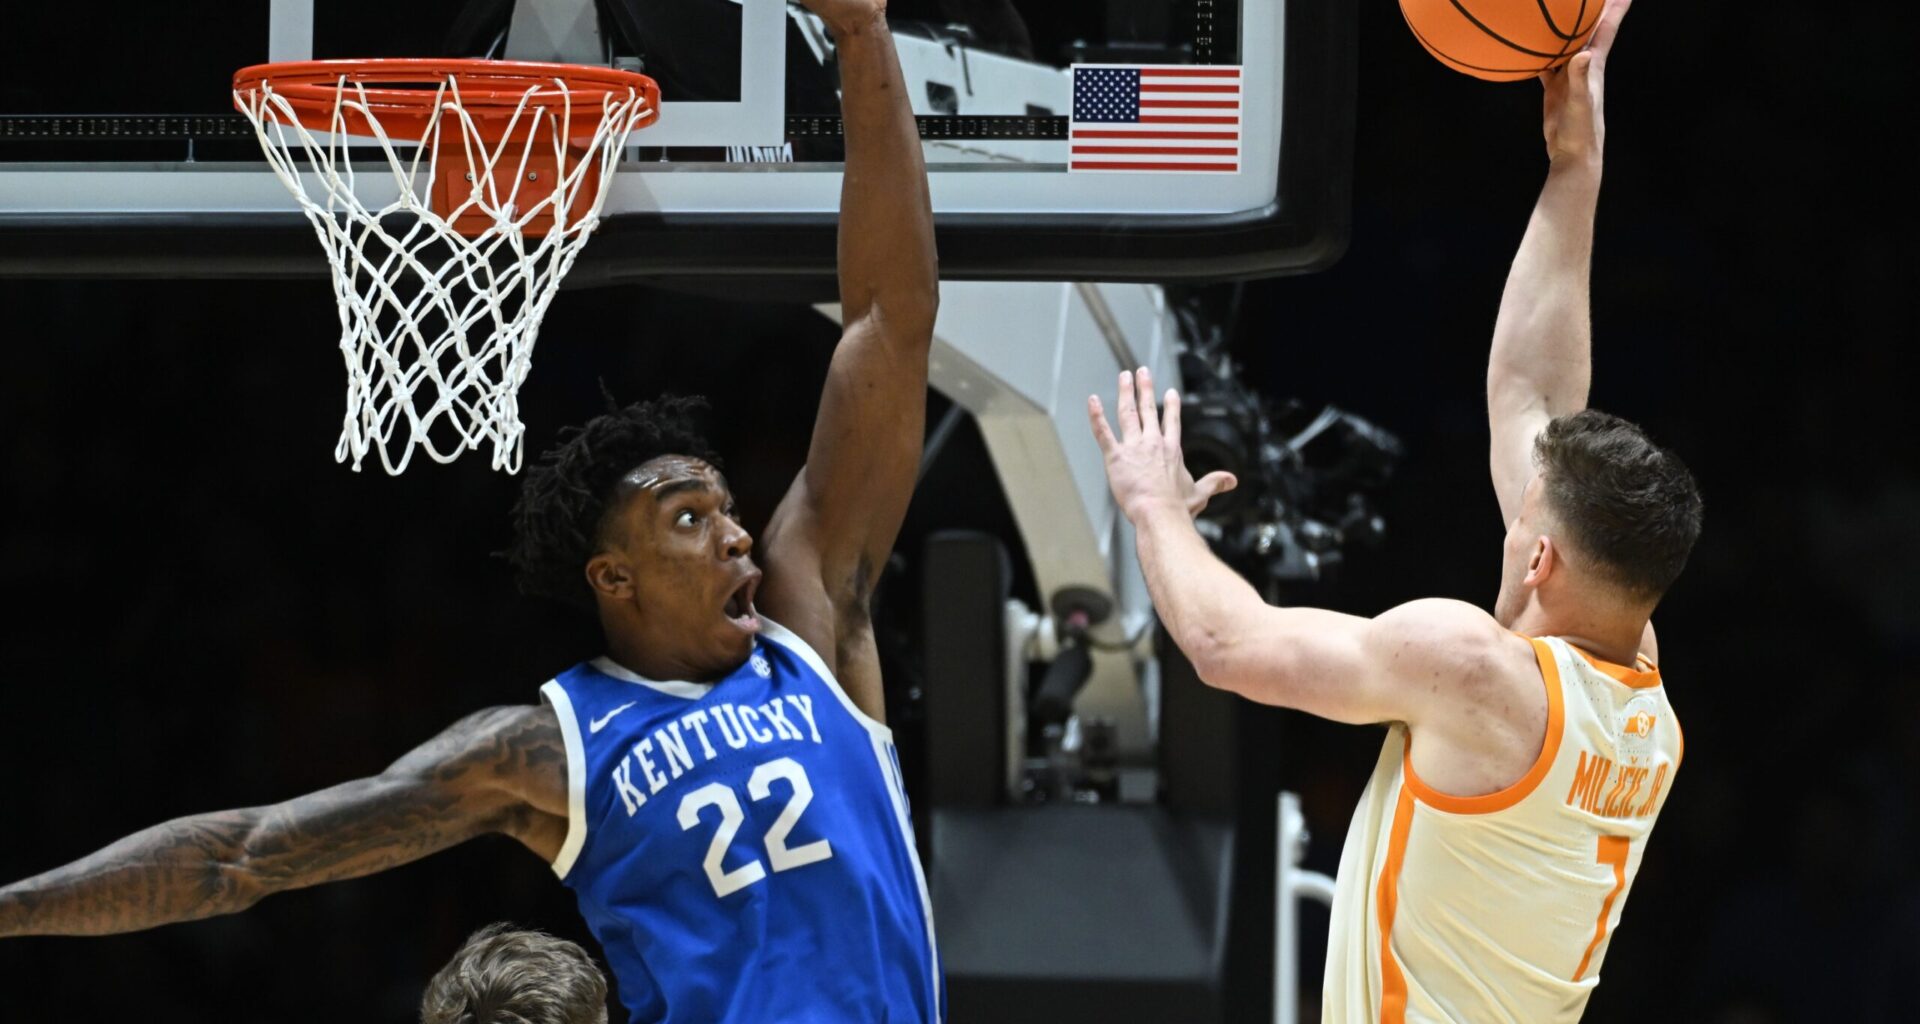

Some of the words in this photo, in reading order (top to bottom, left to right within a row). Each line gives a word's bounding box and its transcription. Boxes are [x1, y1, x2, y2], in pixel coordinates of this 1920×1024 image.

[611, 695, 822, 817] KENTUCKY
[676, 757, 832, 898] 22
[1571, 835, 1630, 982] 7
